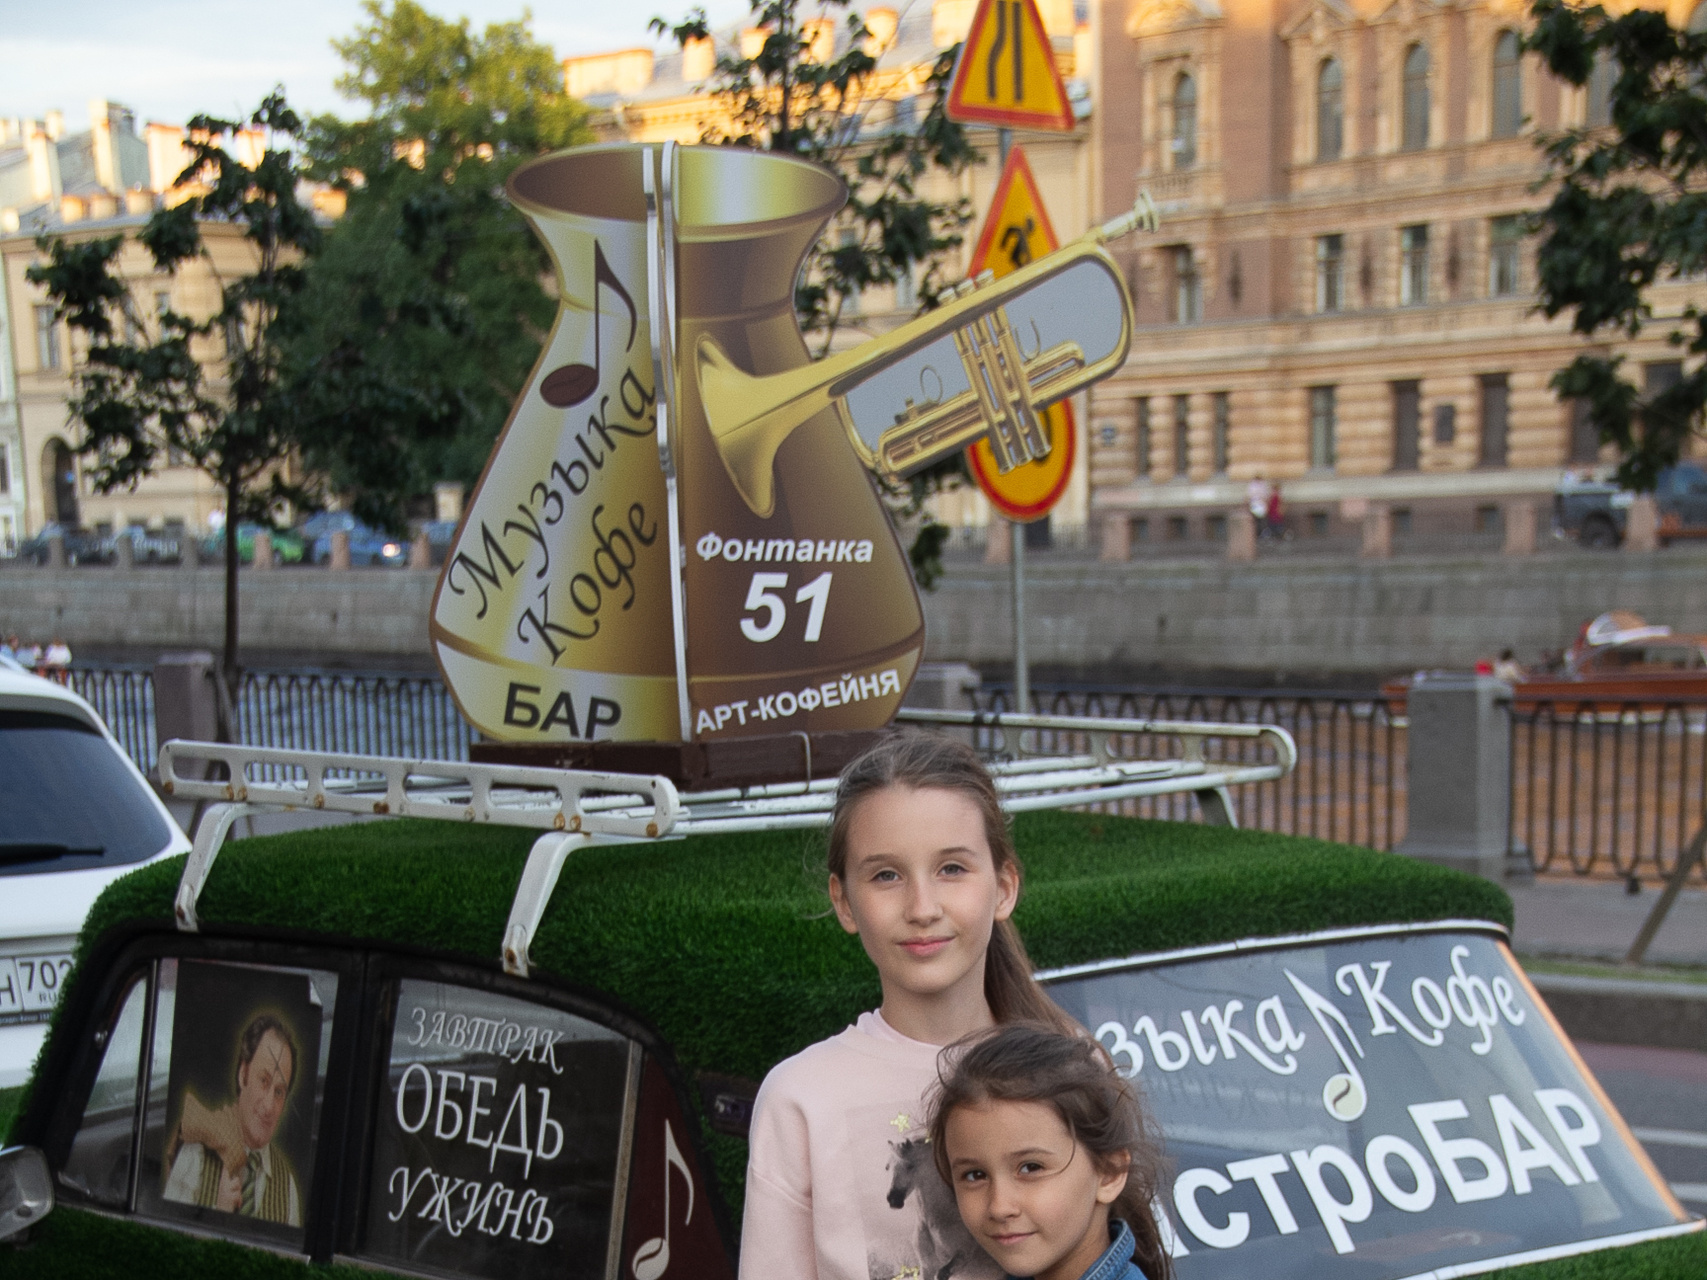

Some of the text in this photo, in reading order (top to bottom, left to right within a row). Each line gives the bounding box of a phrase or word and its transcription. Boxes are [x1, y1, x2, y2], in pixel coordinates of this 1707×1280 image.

[448, 366, 657, 620] Музыка
[696, 532, 874, 563] Фонтанка
[517, 502, 658, 667] Кофе
[740, 571, 833, 643] 51
[503, 681, 622, 741] БАР
[696, 668, 900, 735] АРТ-КОФЕЙНЯ
[407, 1007, 567, 1076] ЗАВТРАК
[1094, 945, 1526, 1079] зыка Кофе
[1149, 1087, 1602, 1260] строБАР
